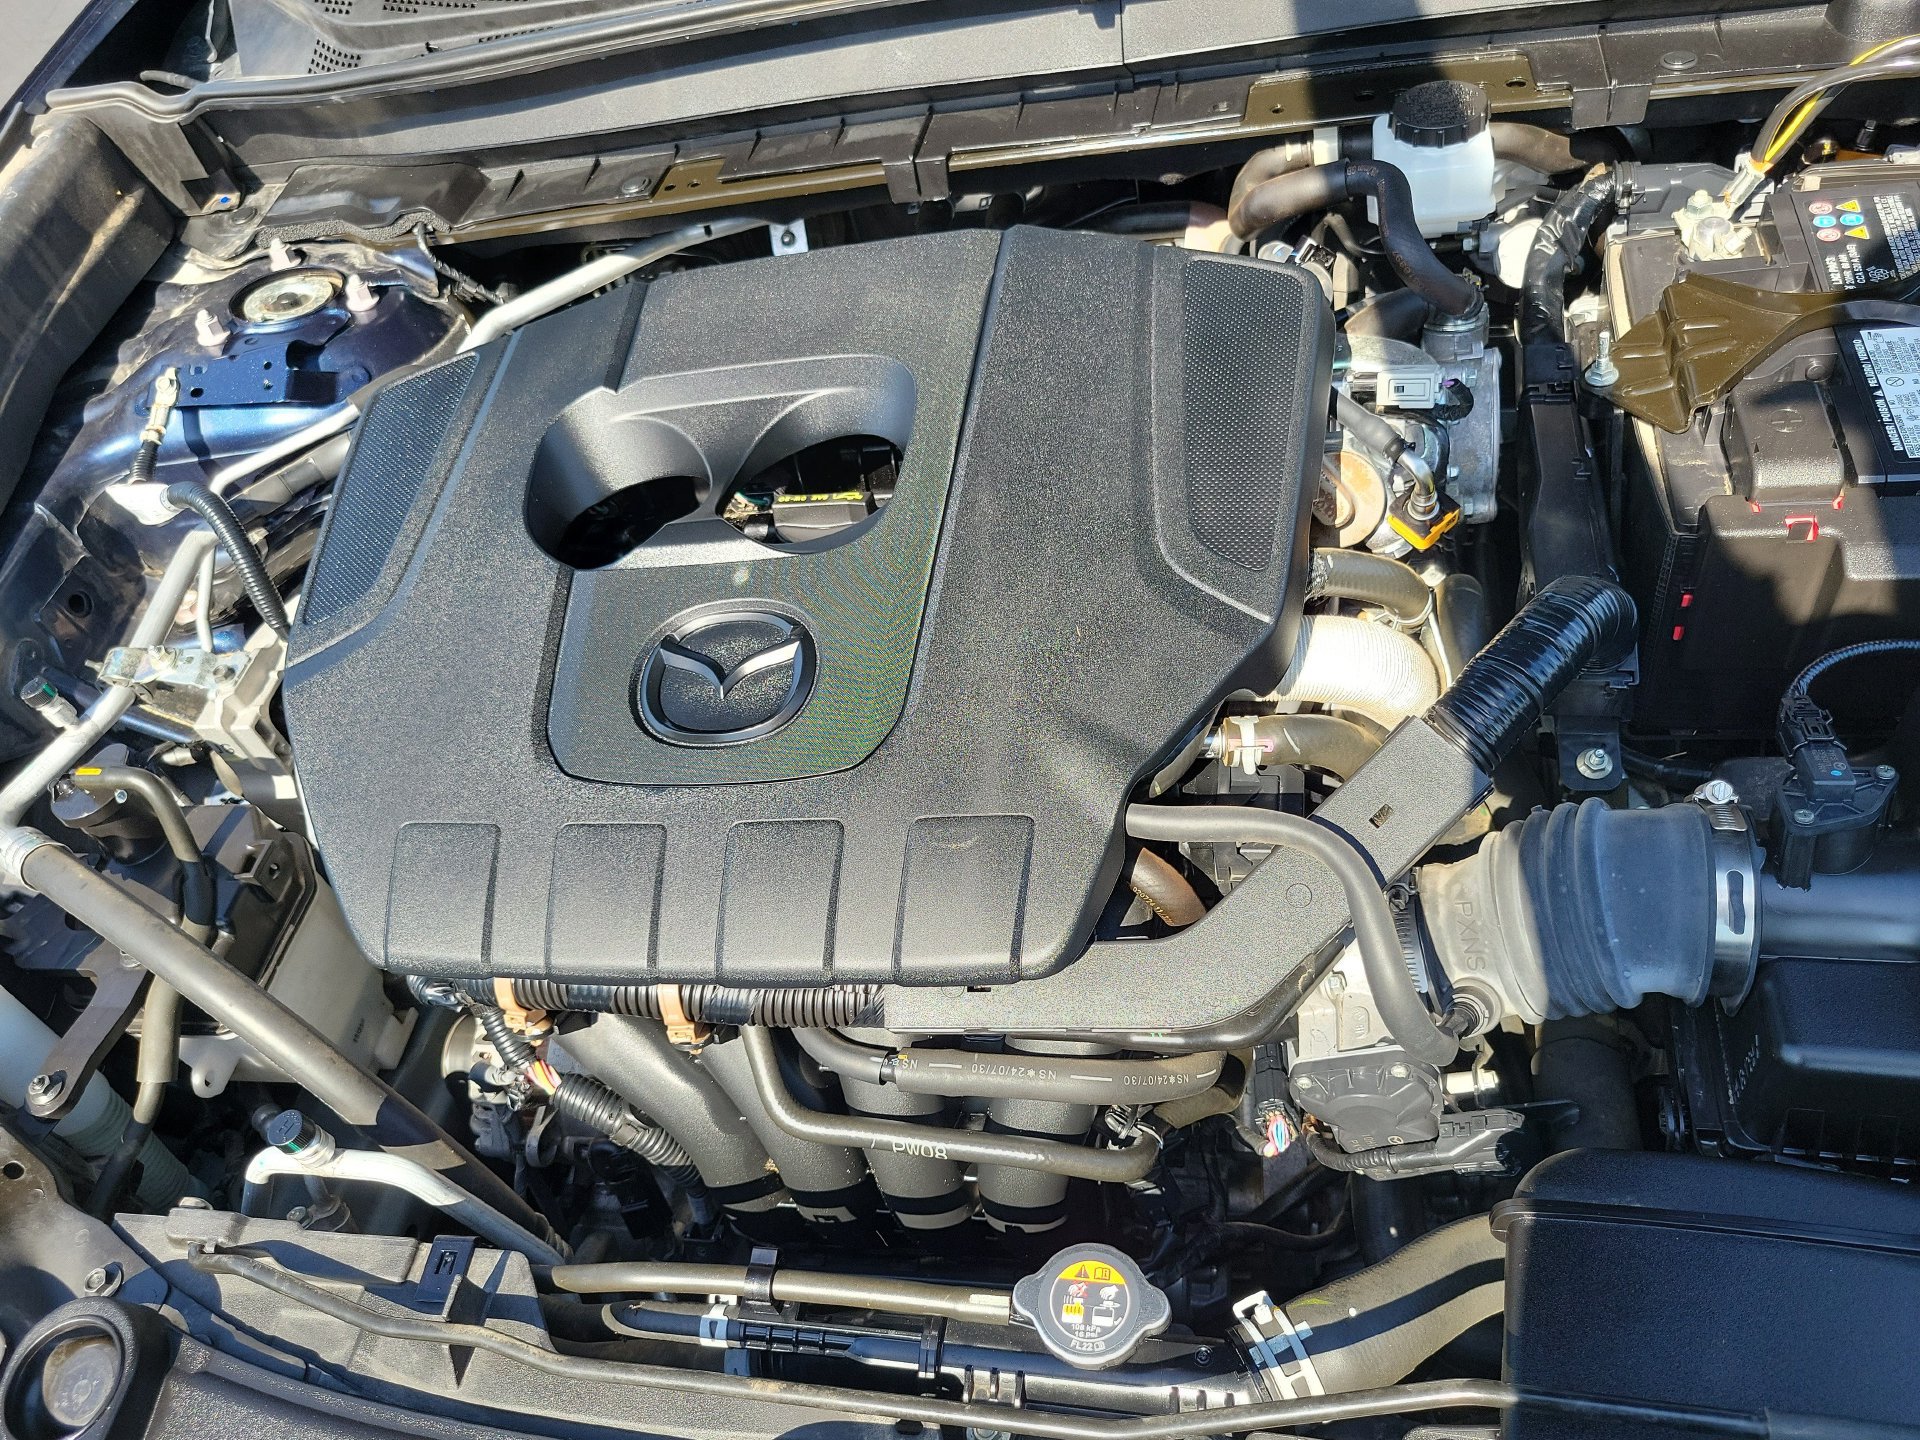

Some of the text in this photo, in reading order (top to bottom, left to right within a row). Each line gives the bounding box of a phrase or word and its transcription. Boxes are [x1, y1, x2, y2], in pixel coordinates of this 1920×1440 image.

[1853, 339, 1869, 360] VENENO
[1862, 364, 1880, 387] PELIGRO
[1875, 399, 1893, 422] POISON
[1885, 425, 1904, 451] DANGER
[1455, 901, 1486, 971] PXNS
[892, 1139, 948, 1160] PW08
[1086, 1324, 1101, 1333] kPa
[1070, 1340, 1094, 1351] FL22
